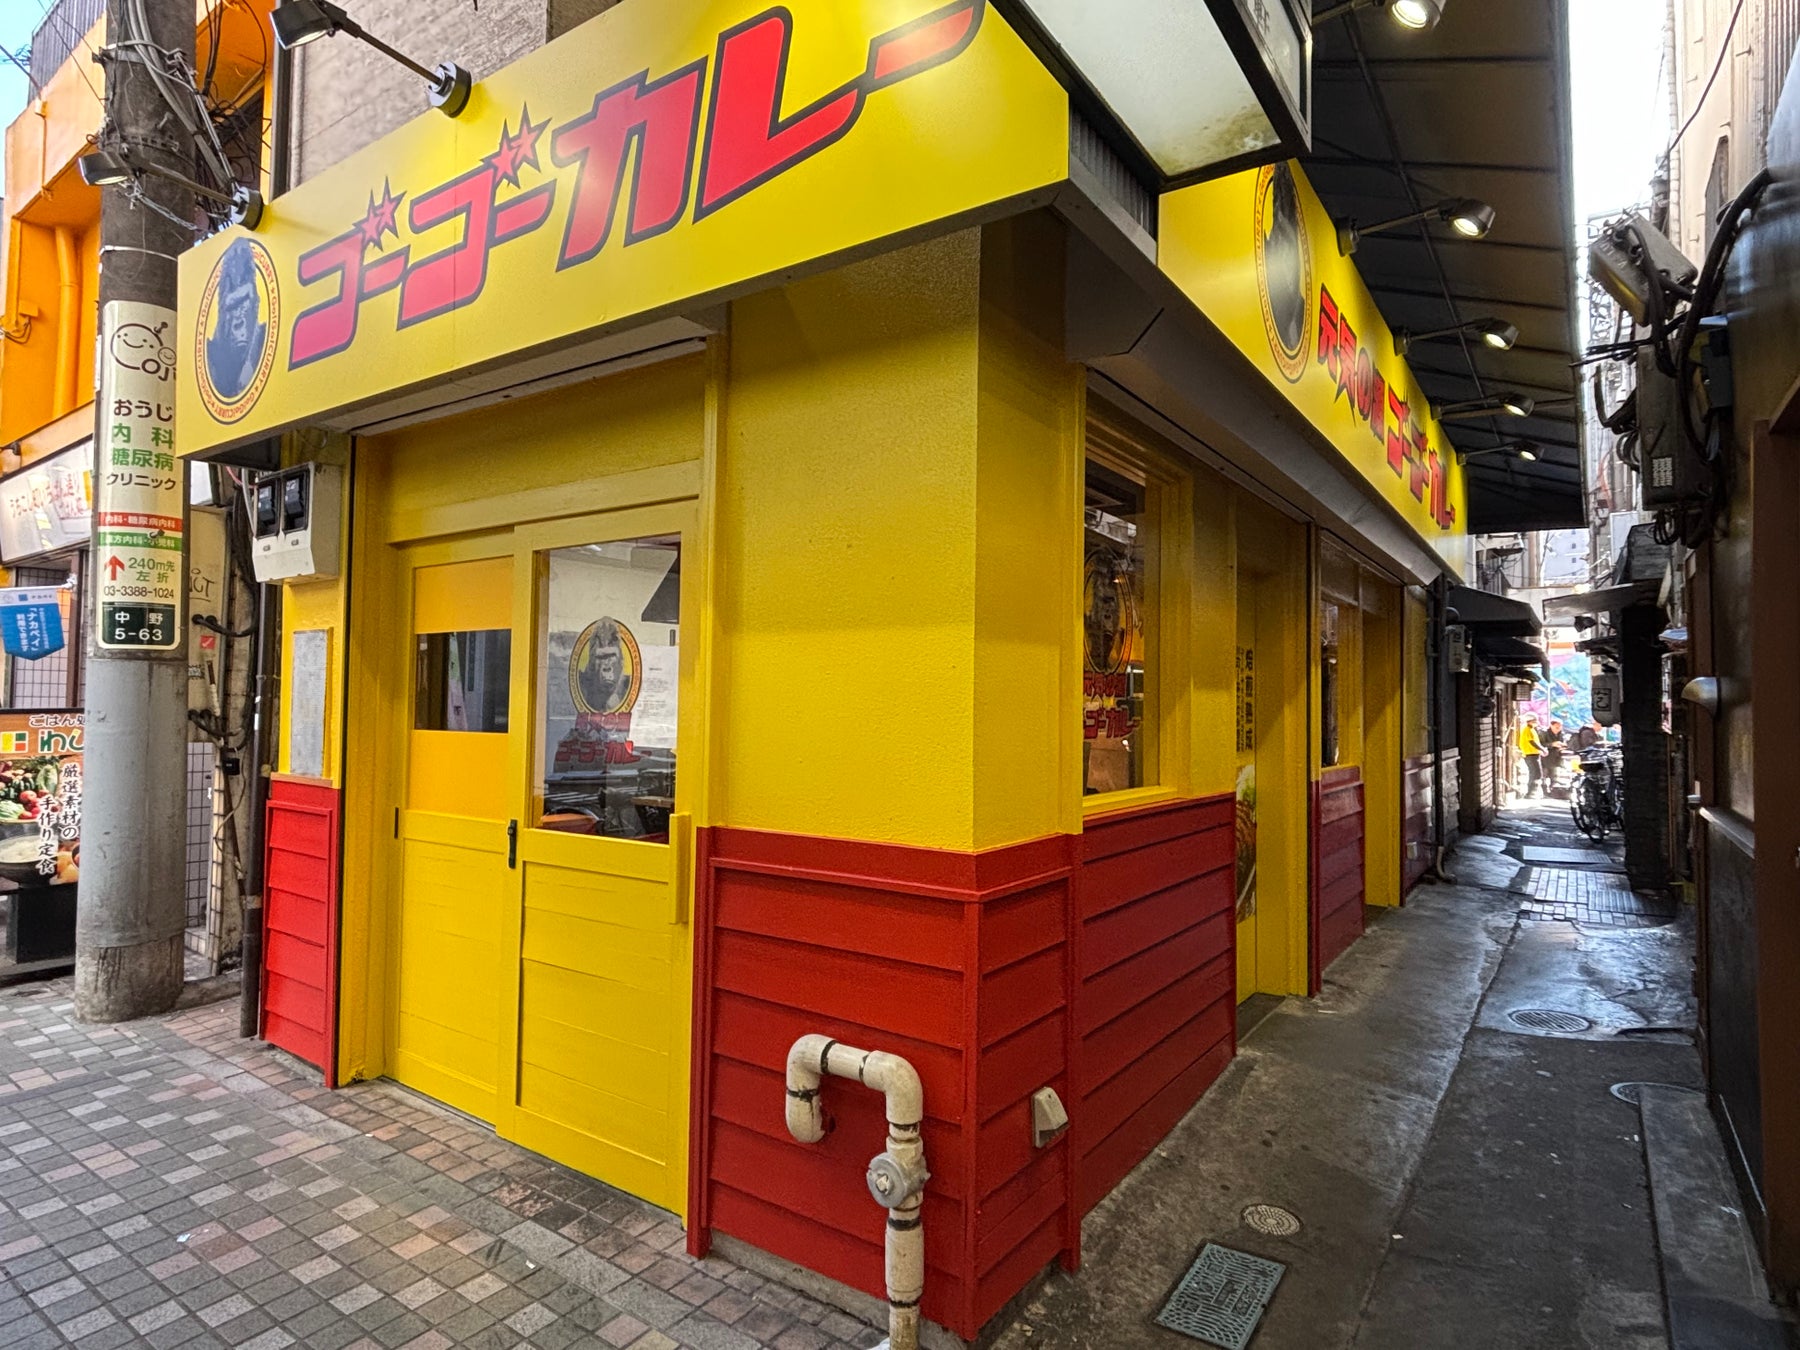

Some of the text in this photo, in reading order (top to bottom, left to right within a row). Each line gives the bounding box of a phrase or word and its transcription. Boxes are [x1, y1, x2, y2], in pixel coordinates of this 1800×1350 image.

[288, 0, 983, 370] ゴーゴーカレー
[113, 399, 173, 422] おうじ
[112, 447, 174, 471] 糖尿病
[107, 472, 176, 490] クリニック
[128, 557, 175, 572] 240m先
[104, 586, 174, 598] 03-3388-1024
[115, 611, 163, 625] 中野
[115, 628, 162, 640] 5-63
[62, 763, 80, 839] 厳選素材の
[38, 796, 57, 875] 手作り定食
